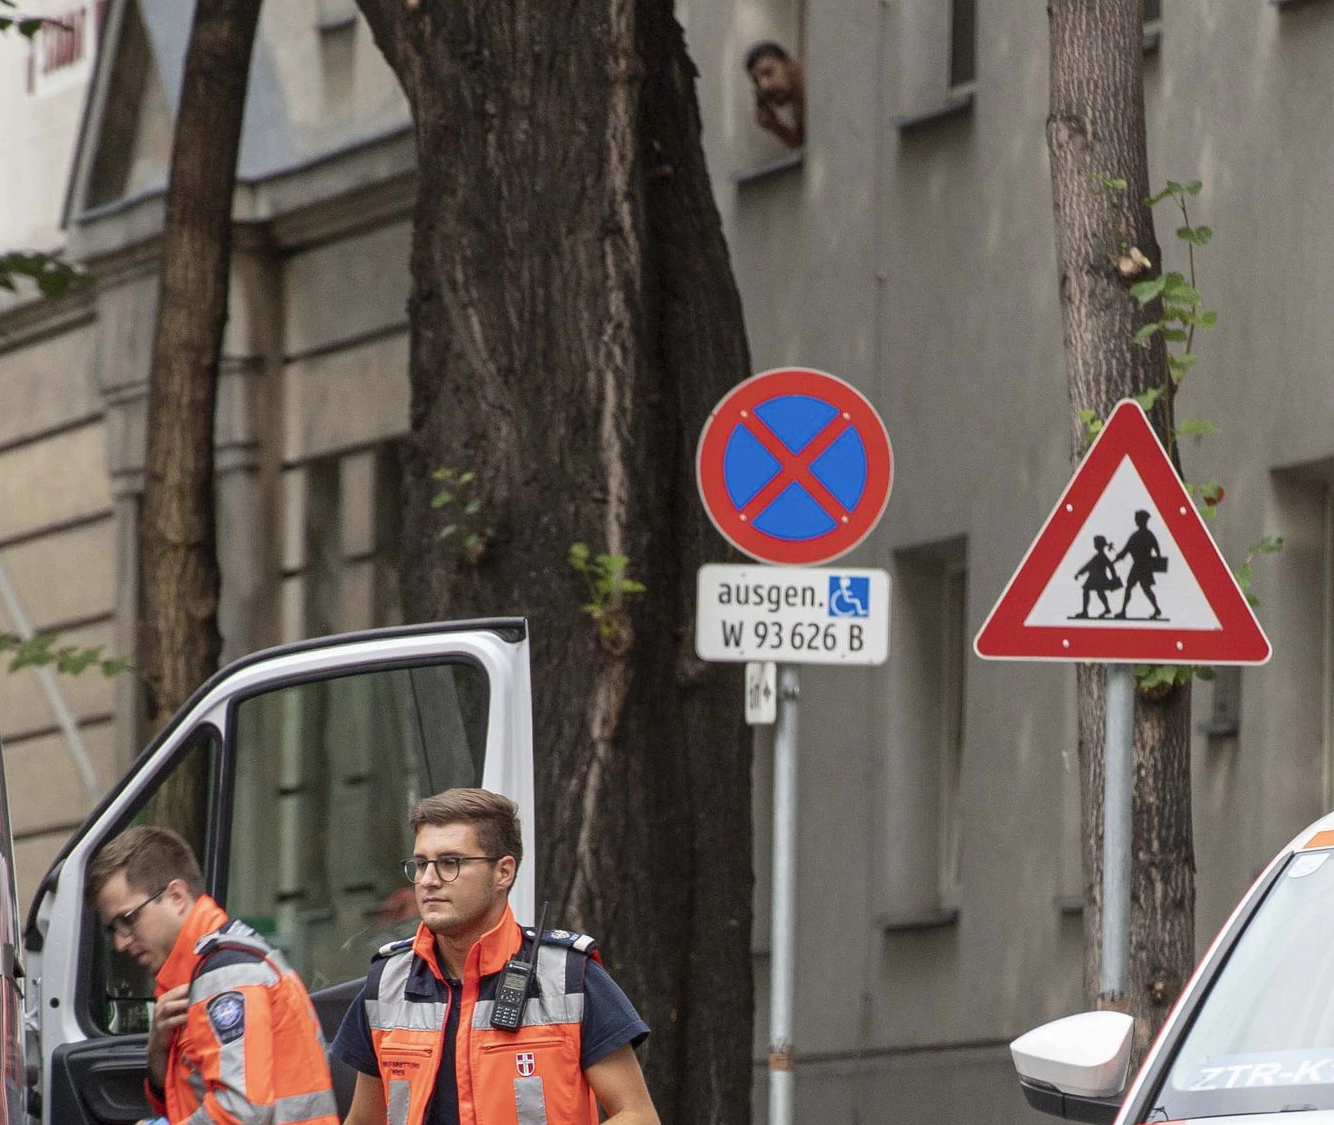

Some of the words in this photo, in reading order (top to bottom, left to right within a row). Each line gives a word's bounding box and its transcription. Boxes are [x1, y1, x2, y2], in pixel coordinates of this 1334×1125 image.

[718, 583, 824, 613] ausgen.
[722, 620, 744, 648] W
[849, 624, 864, 652] B
